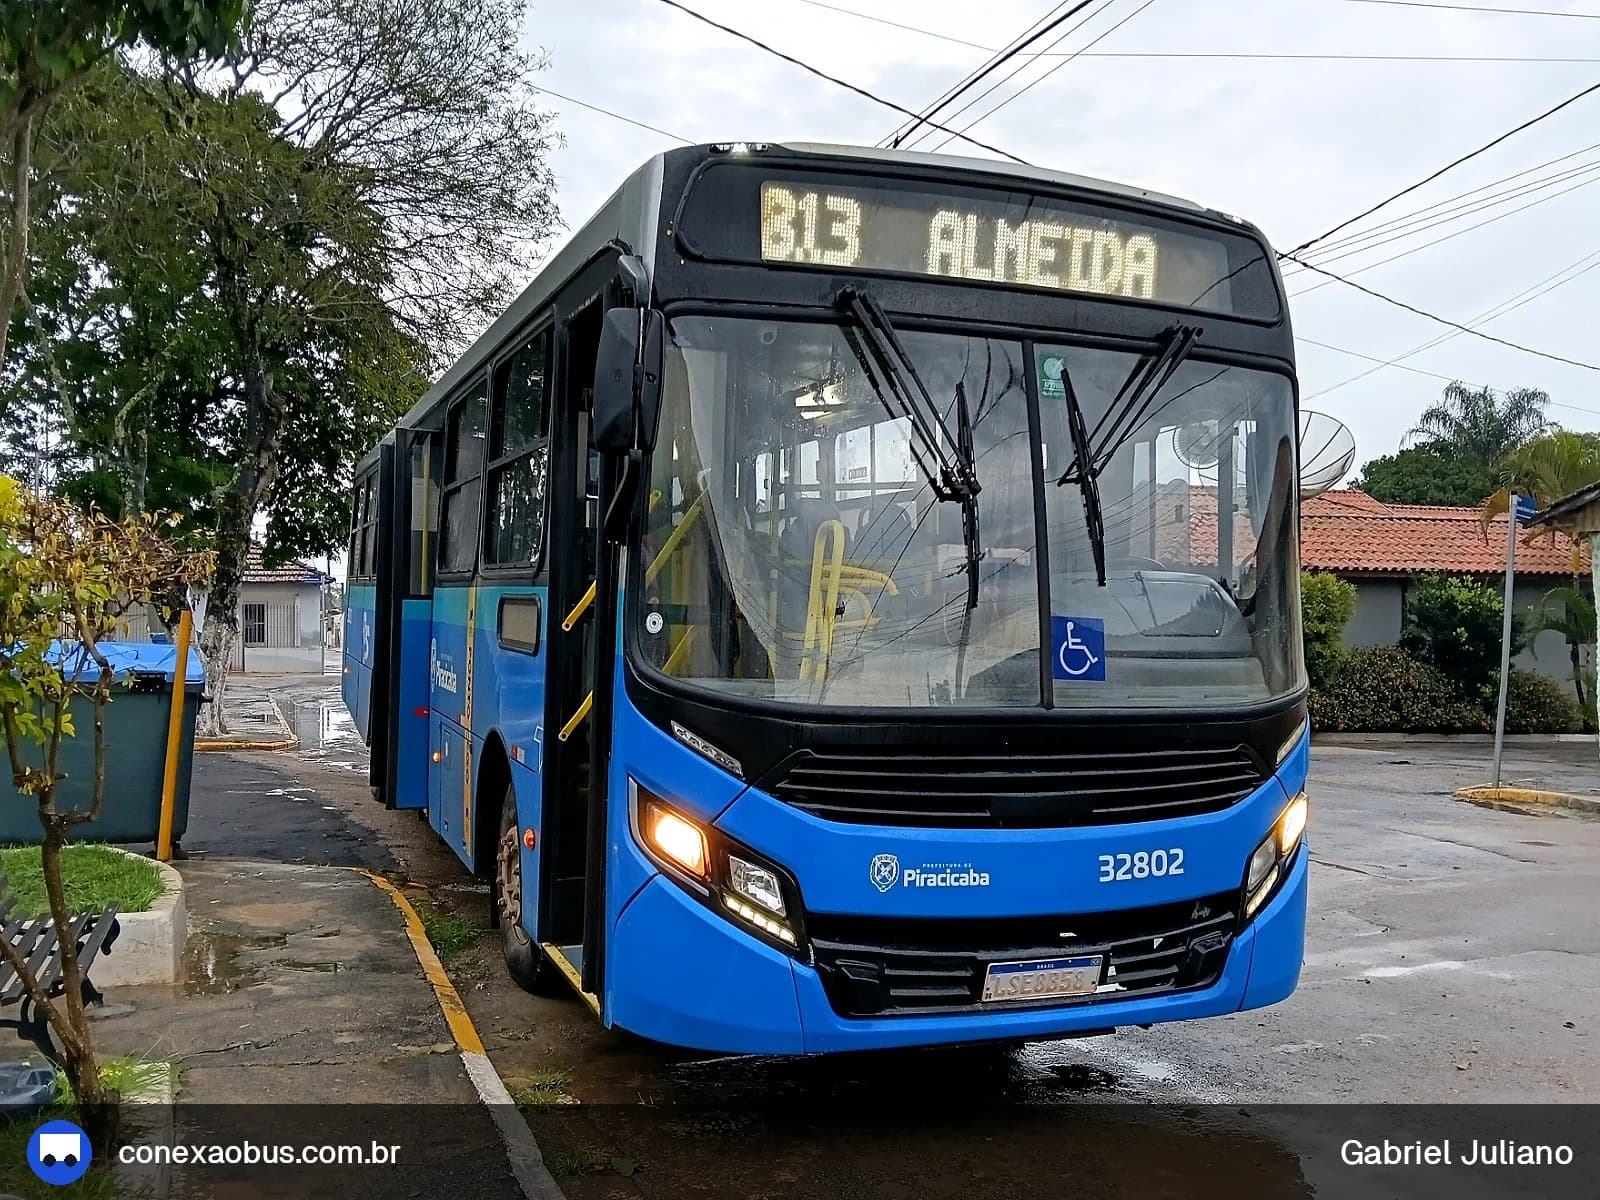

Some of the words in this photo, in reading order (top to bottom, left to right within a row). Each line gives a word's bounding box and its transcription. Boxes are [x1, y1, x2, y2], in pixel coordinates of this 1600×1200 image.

[927, 210, 1157, 299] ALMEIDA
[903, 868, 990, 887] Piracicaba
[1099, 848, 1184, 882] 32802
